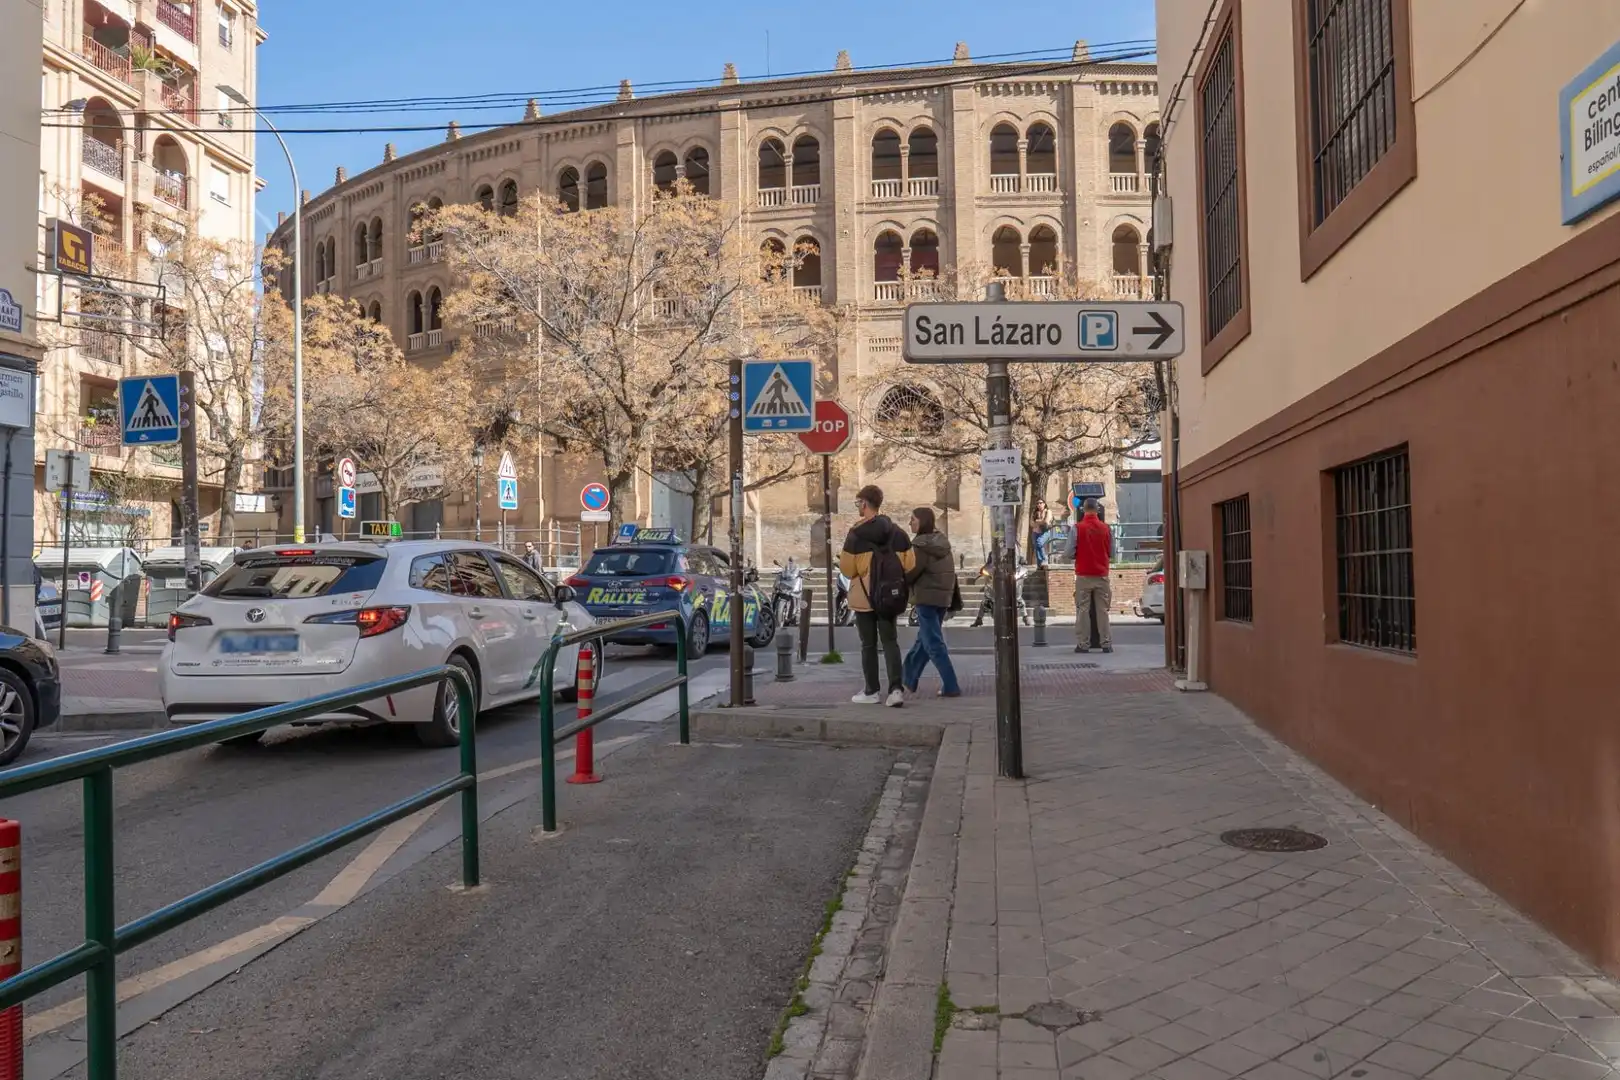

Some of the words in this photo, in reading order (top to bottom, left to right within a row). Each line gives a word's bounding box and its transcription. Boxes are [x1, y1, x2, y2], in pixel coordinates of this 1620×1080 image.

[58, 256, 89, 273] TABACOS
[915, 315, 964, 345] San
[974, 315, 1062, 345] Lázaro
[814, 420, 845, 433] TOP
[586, 587, 645, 605] RALLYE
[710, 589, 757, 624] RAYE
